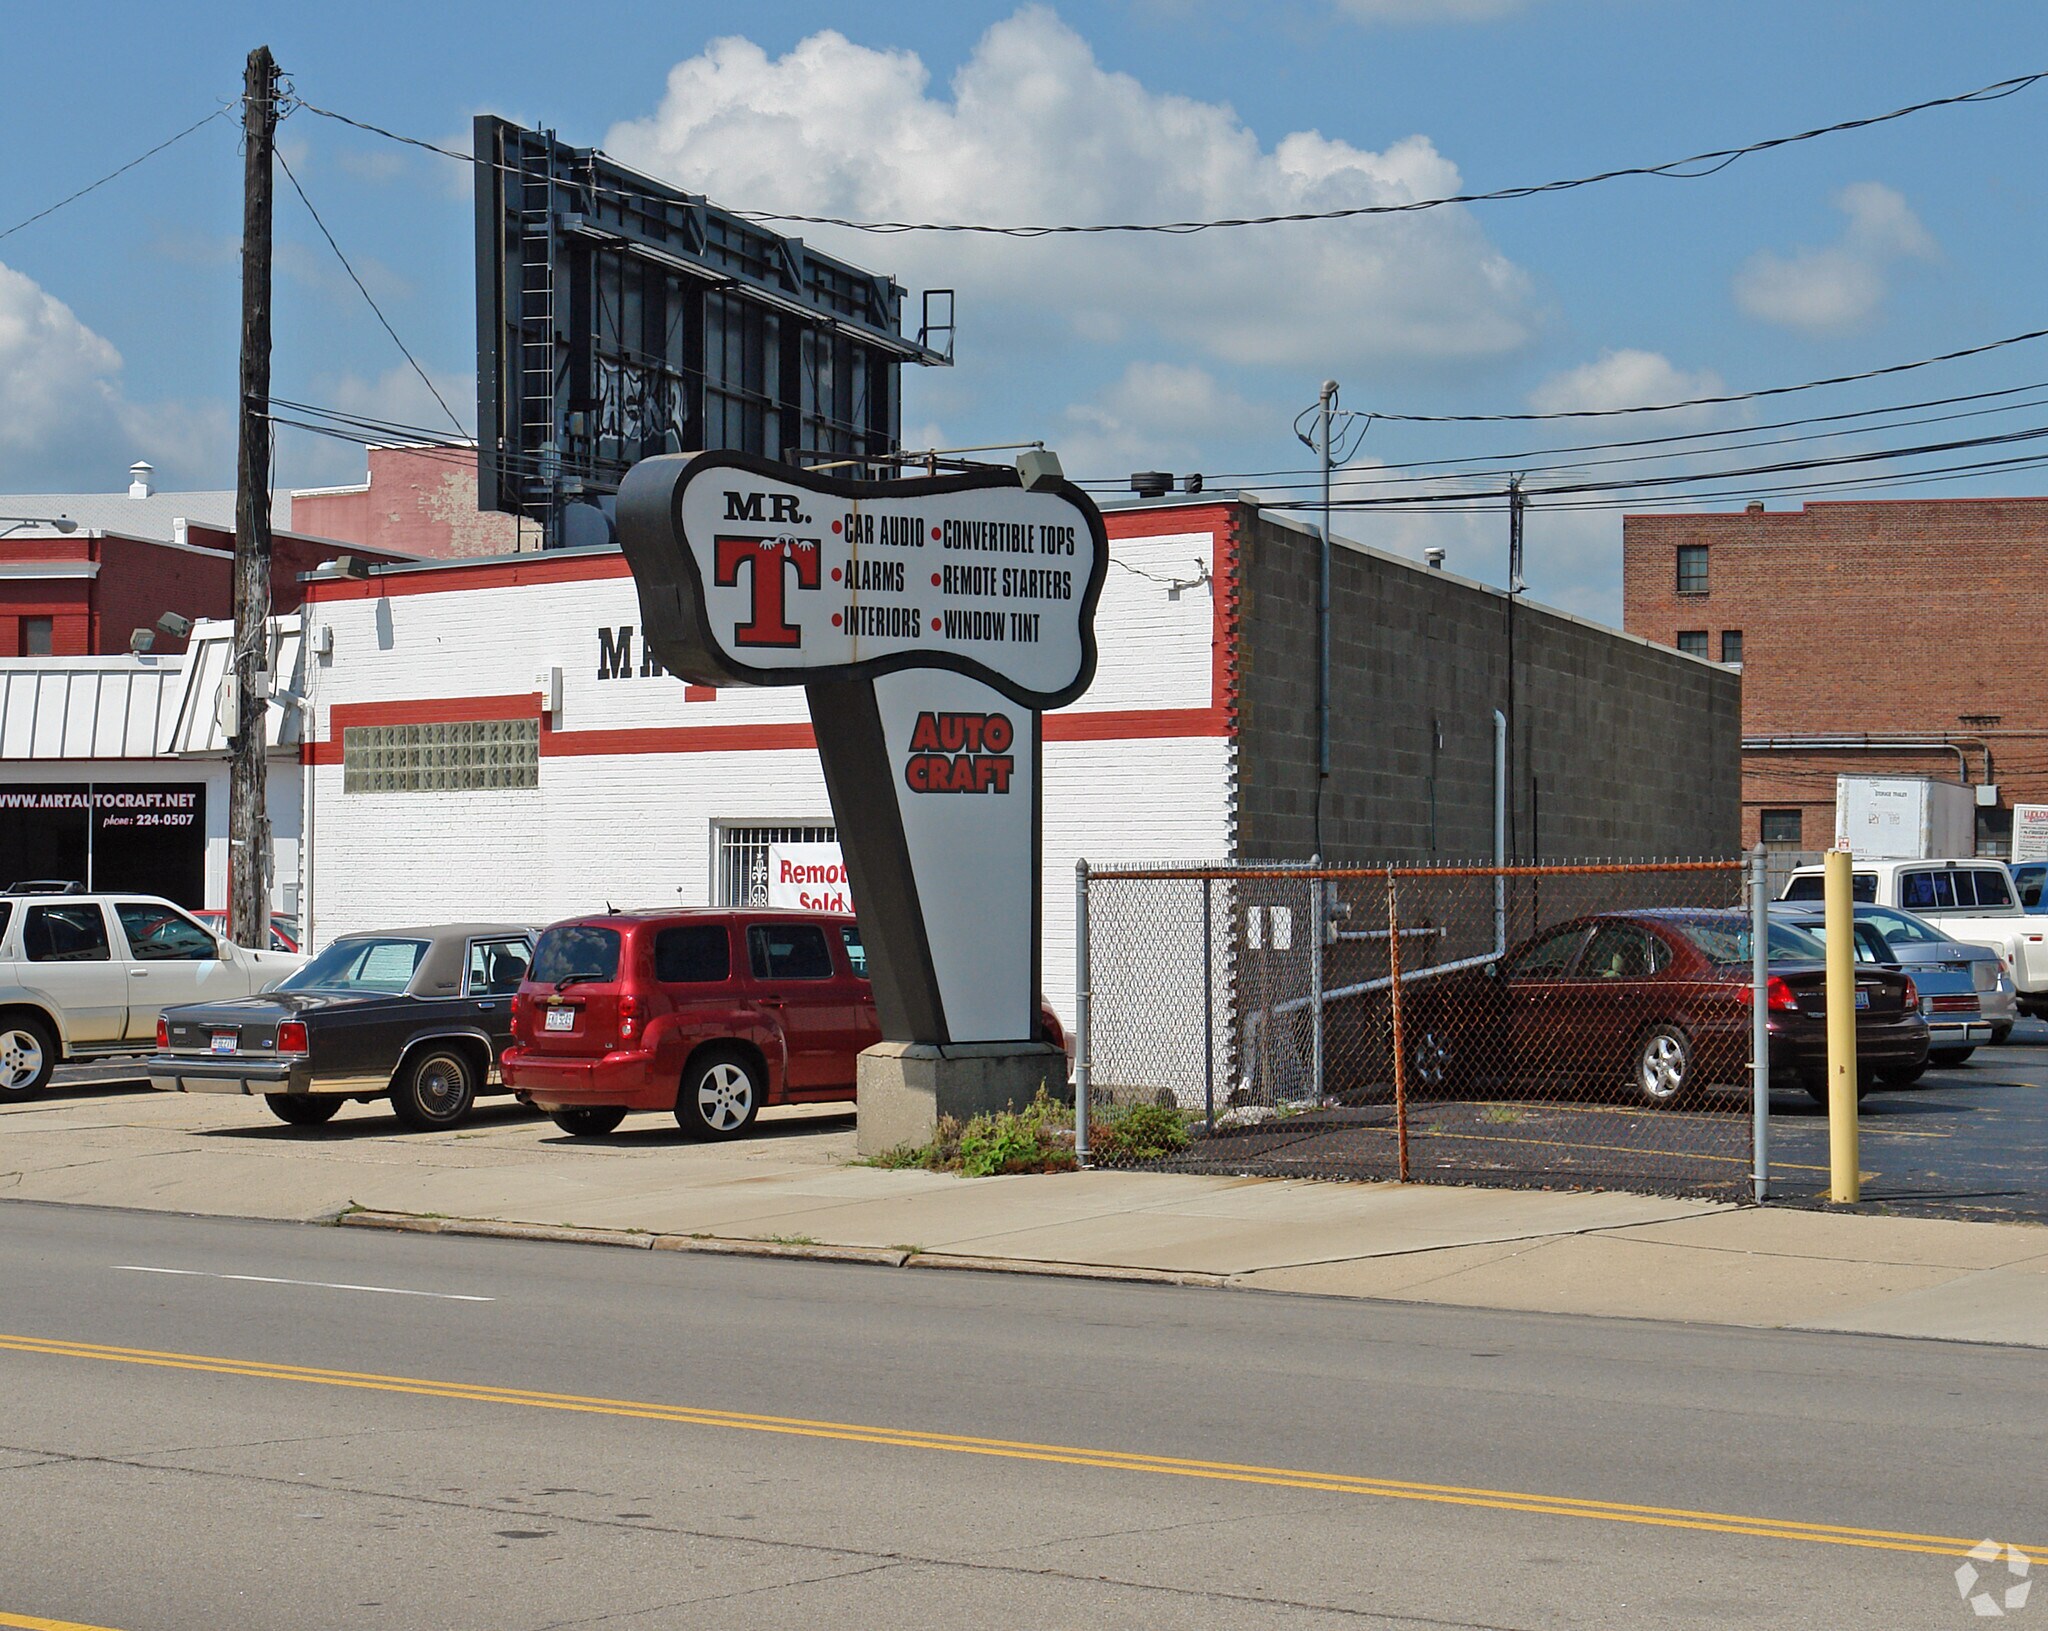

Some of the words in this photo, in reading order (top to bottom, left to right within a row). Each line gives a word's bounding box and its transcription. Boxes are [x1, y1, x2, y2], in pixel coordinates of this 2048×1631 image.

[723, 491, 812, 524] MR.
[844, 513, 874, 545] CAR
[880, 515, 925, 548] AUDIO
[943, 519, 1034, 554] CONVERTIBLE
[1039, 525, 1075, 556] TOPS
[714, 534, 821, 649] T
[844, 559, 905, 592] ALARMS
[943, 564, 997, 597] REMOTE
[1002, 567, 1071, 600] STARTERS
[844, 605, 921, 638] INTERIORS
[943, 609, 1006, 641] WINDOW
[1010, 612, 1040, 643] TINT
[908, 711, 1014, 754] AUTO
[905, 753, 1014, 794] CRAFT
